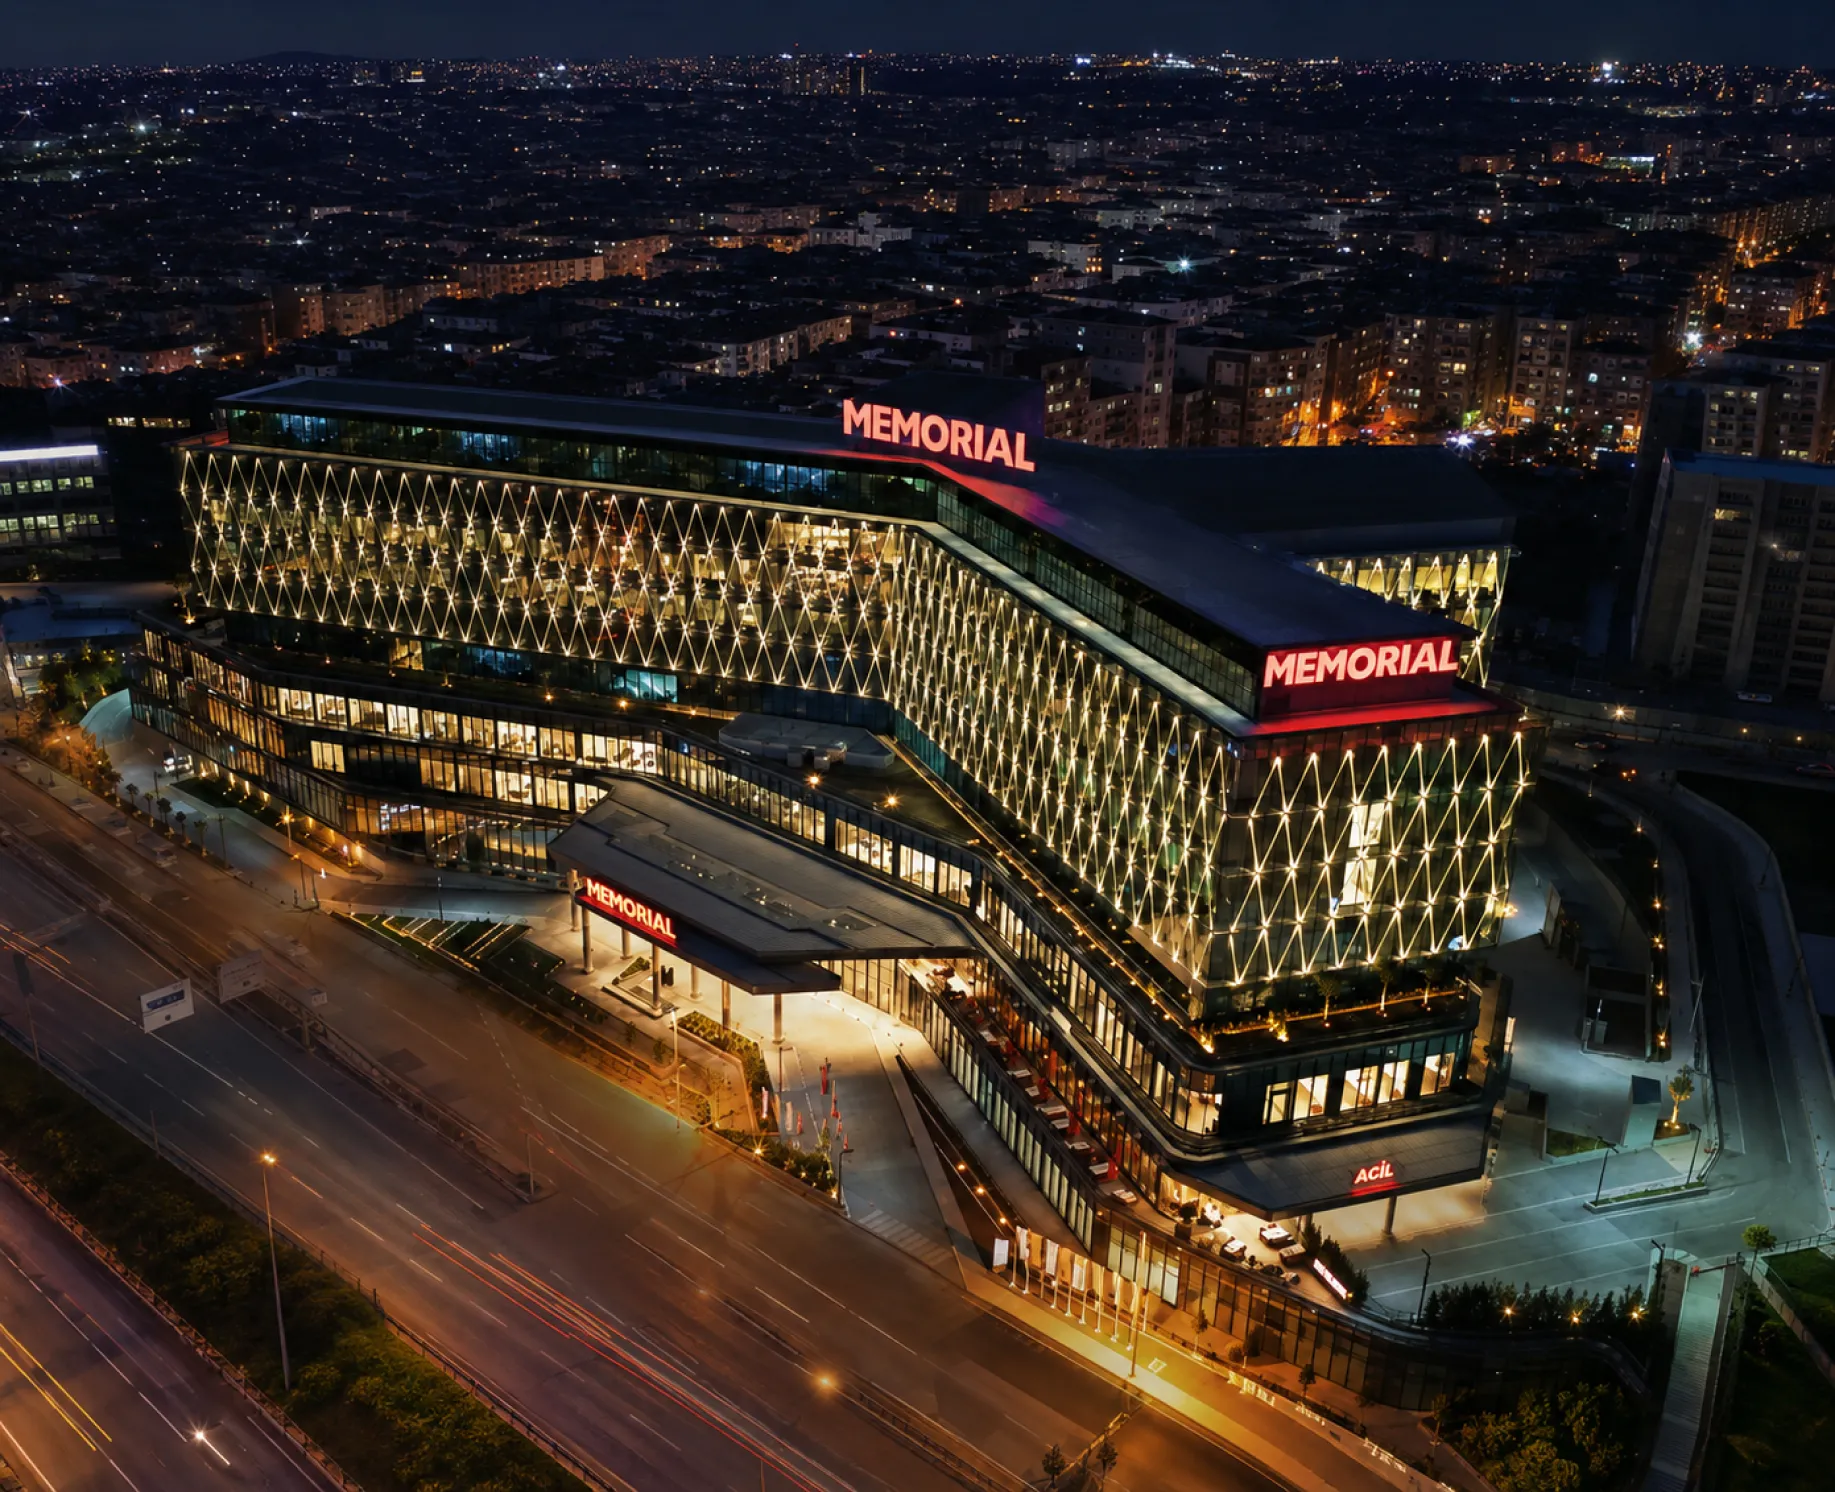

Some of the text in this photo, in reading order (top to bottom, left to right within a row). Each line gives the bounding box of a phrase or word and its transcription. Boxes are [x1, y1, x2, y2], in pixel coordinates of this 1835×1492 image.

[843, 399, 1035, 472] MEMORIAL
[1263, 640, 1459, 688] MEMORIAL
[587, 878, 677, 939] MEMORIAL
[1354, 1160, 1394, 1185] ACİL
